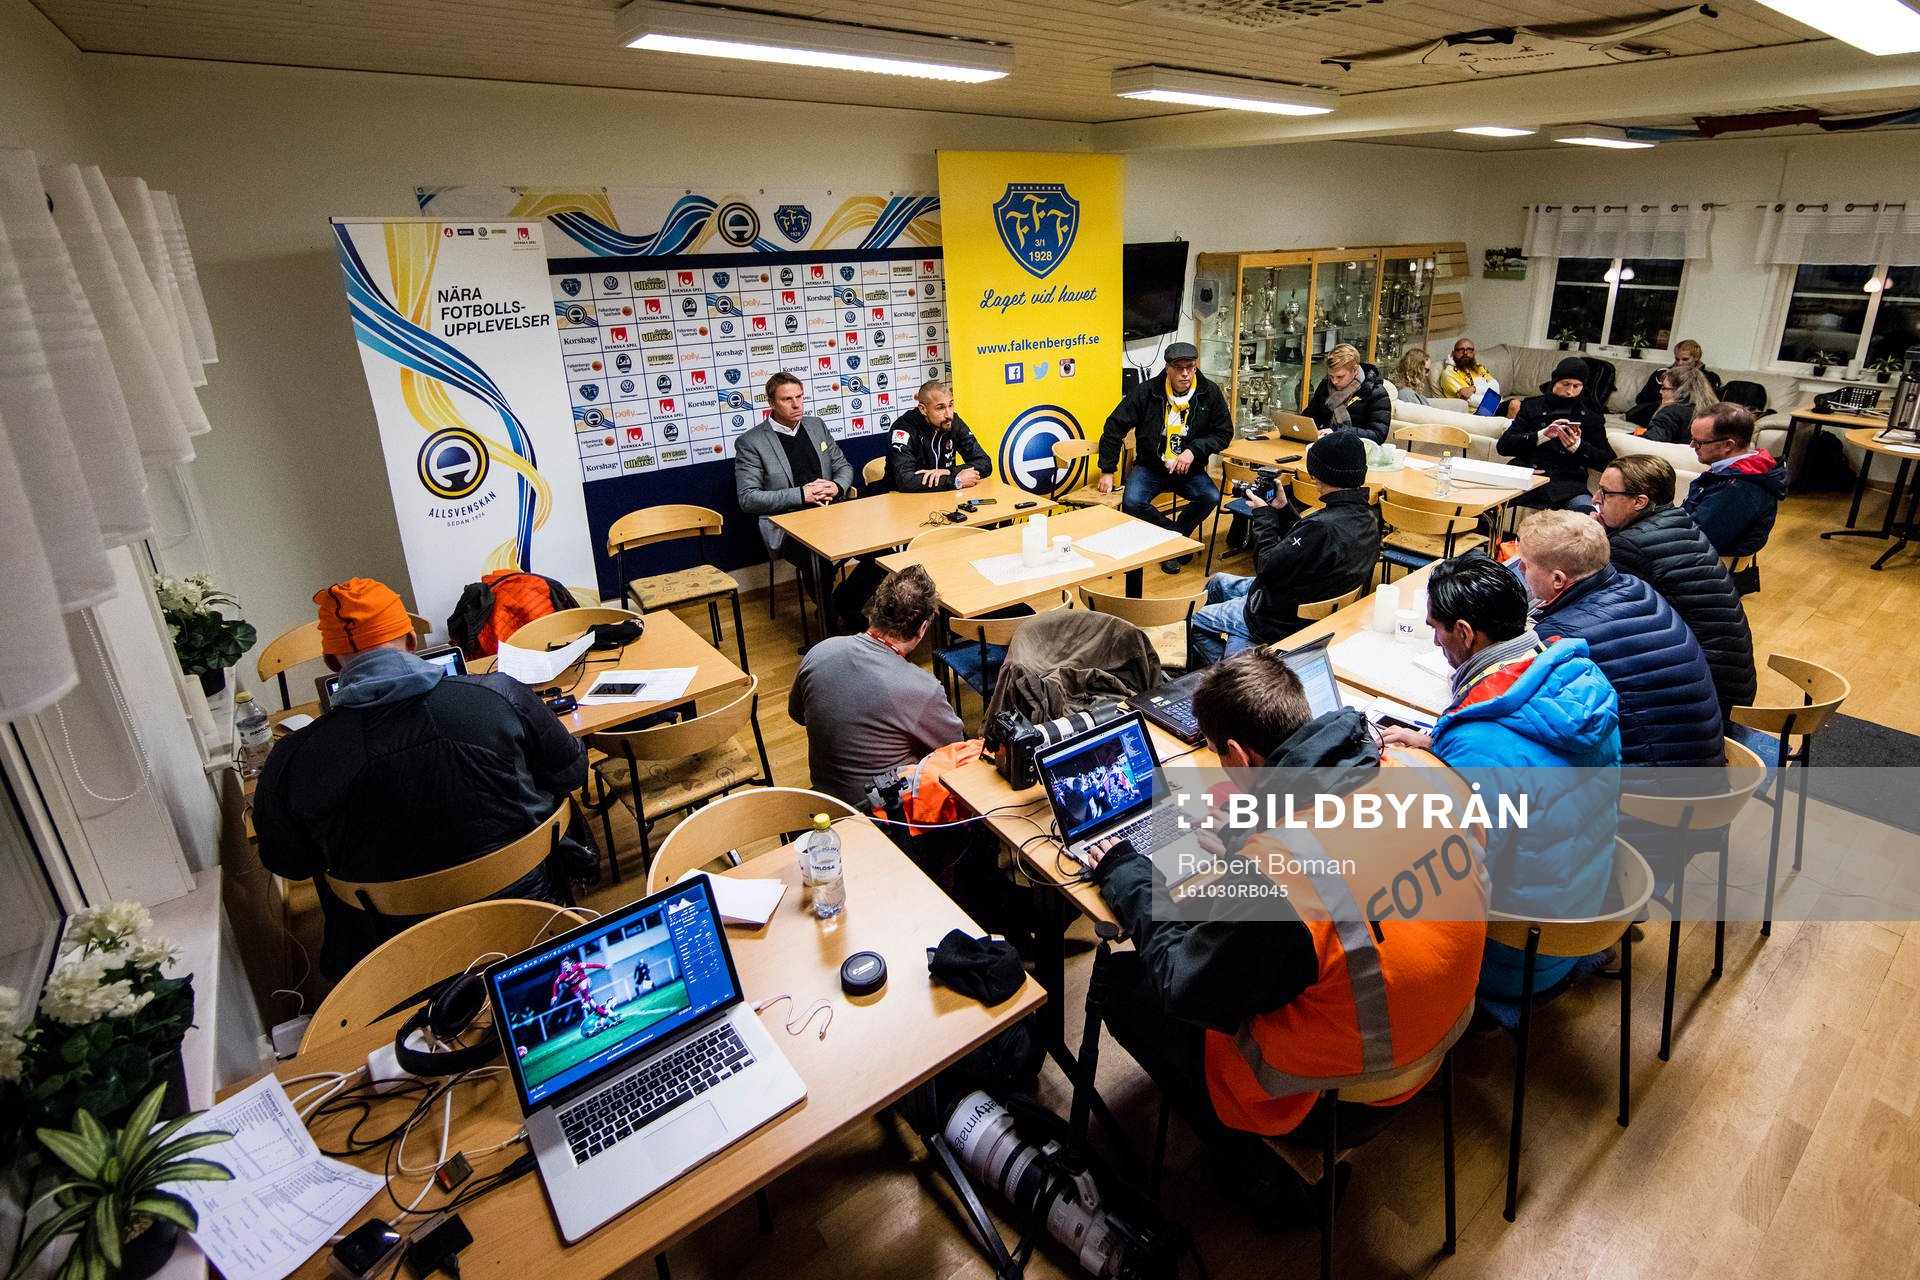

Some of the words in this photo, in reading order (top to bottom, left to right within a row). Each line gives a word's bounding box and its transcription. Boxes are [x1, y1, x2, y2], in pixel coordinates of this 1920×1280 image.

[1035, 239, 1046, 247] 3/1
[1029, 251, 1053, 262] 1928
[438, 285, 482, 303] NÄRA
[980, 288, 1027, 314] Laget
[1031, 284, 1056, 305] vid
[1057, 284, 1097, 303] havet
[441, 301, 526, 320] FOTBOLLS-
[444, 314, 550, 337] UPPLEVELSER
[977, 333, 1101, 355] www.falkenbergsff.se
[428, 490, 496, 519] ALLSVENSKAN
[1365, 833, 1474, 944] FOTO
